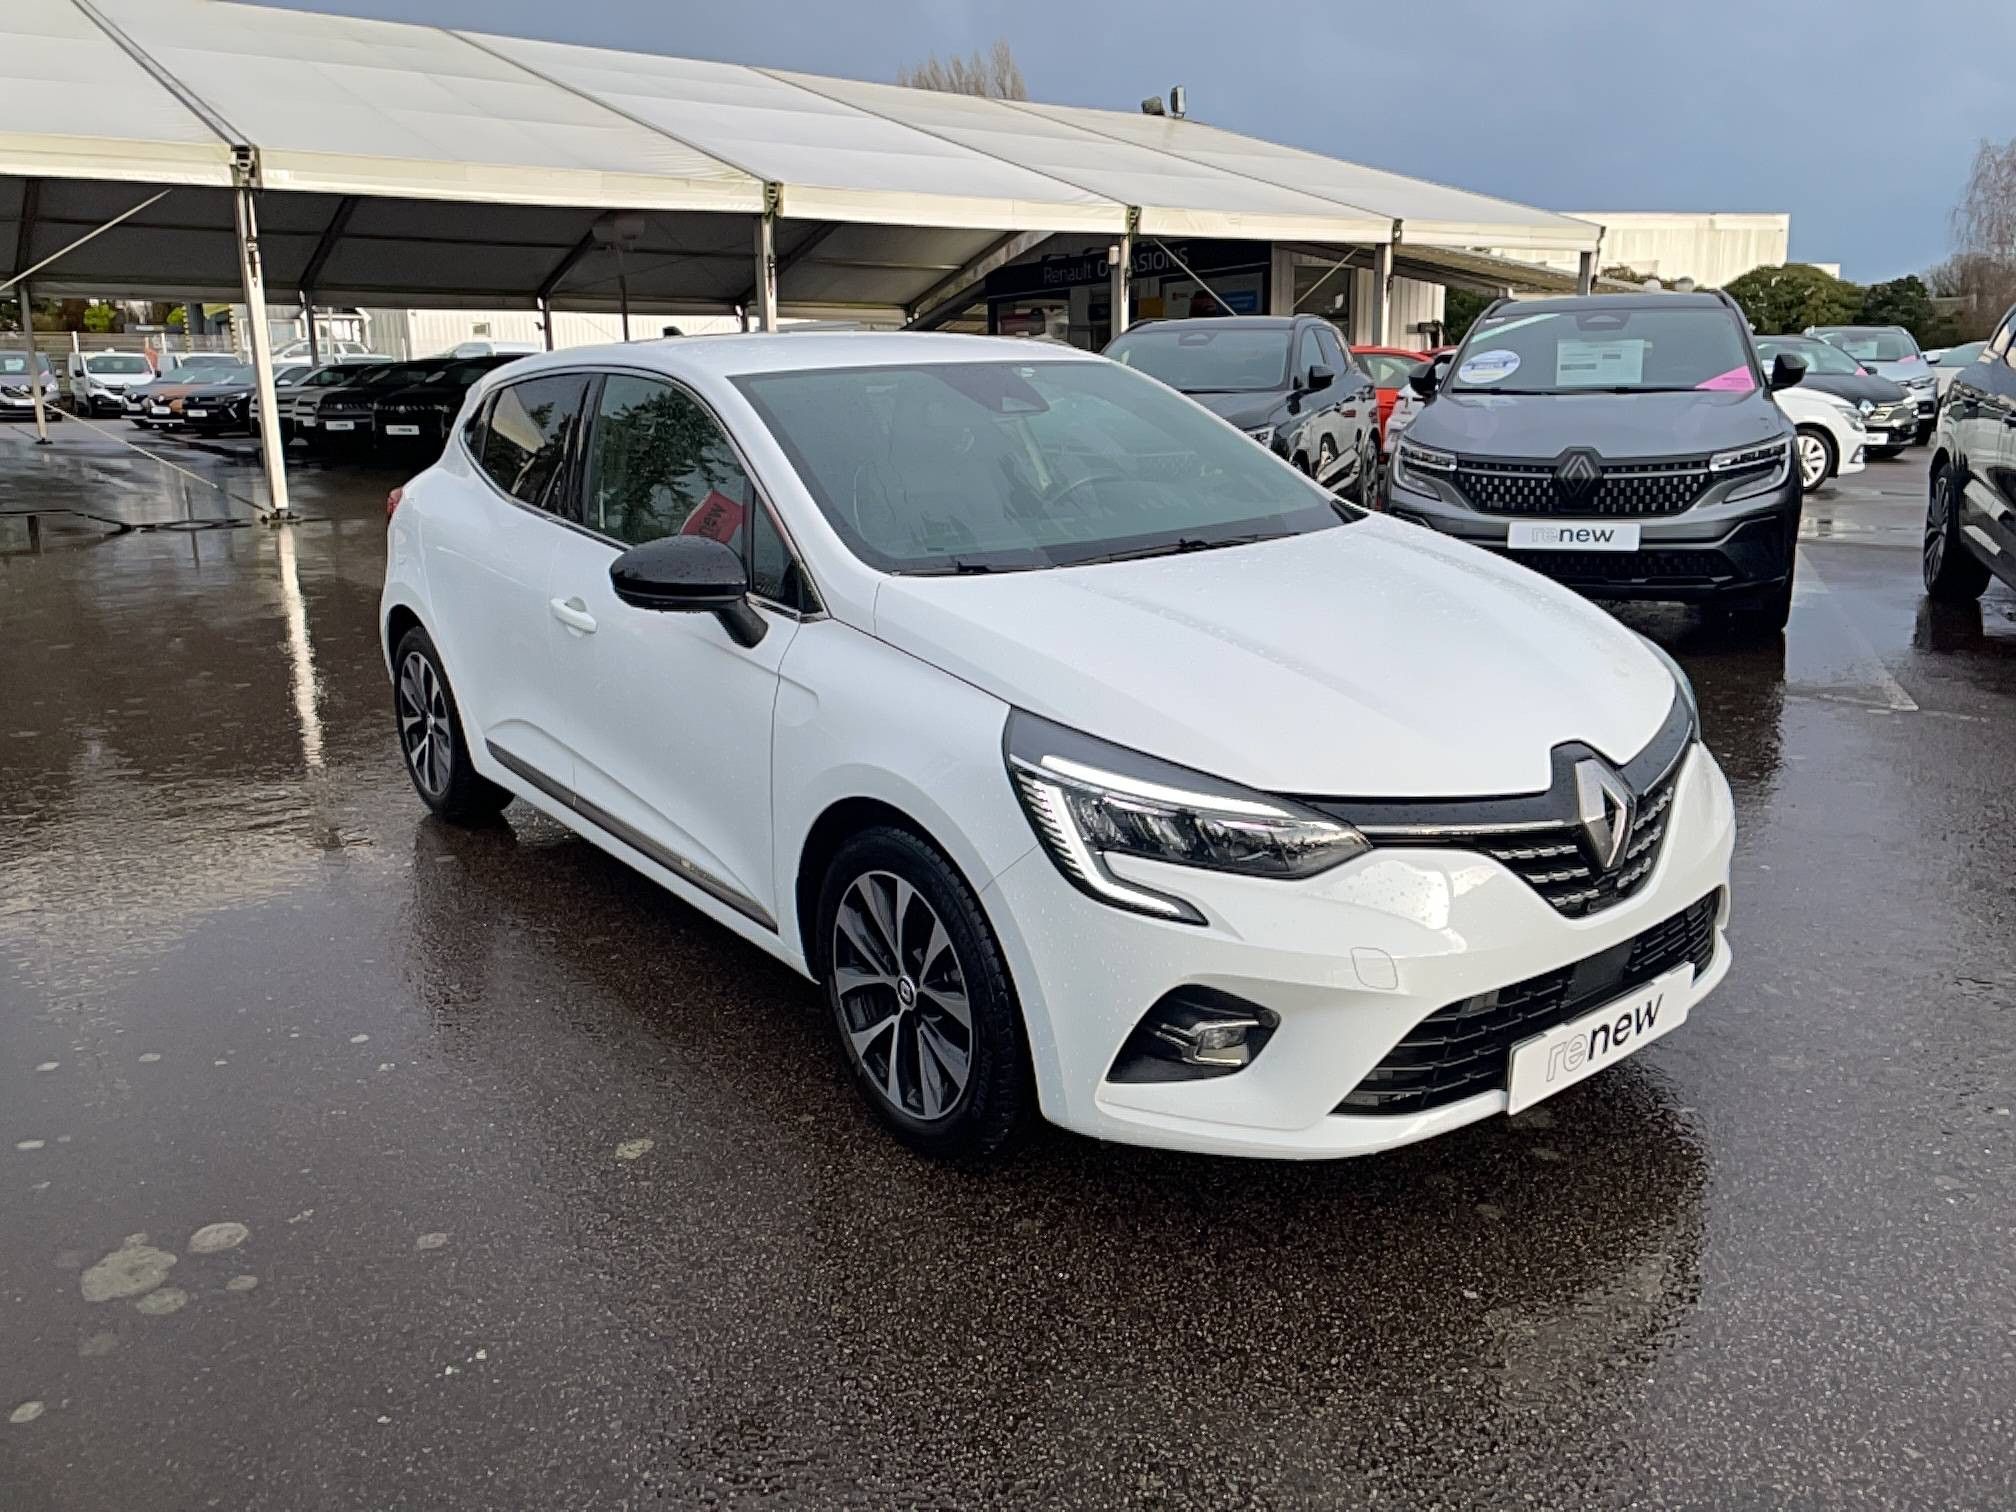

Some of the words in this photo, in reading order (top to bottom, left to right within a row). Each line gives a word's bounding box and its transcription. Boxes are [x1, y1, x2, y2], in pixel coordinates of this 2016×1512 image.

[1043, 258, 1093, 285] Renault
[1097, 247, 1189, 277] OSIONS
[1531, 527, 1615, 544] renew
[1546, 993, 1664, 1082] renew
